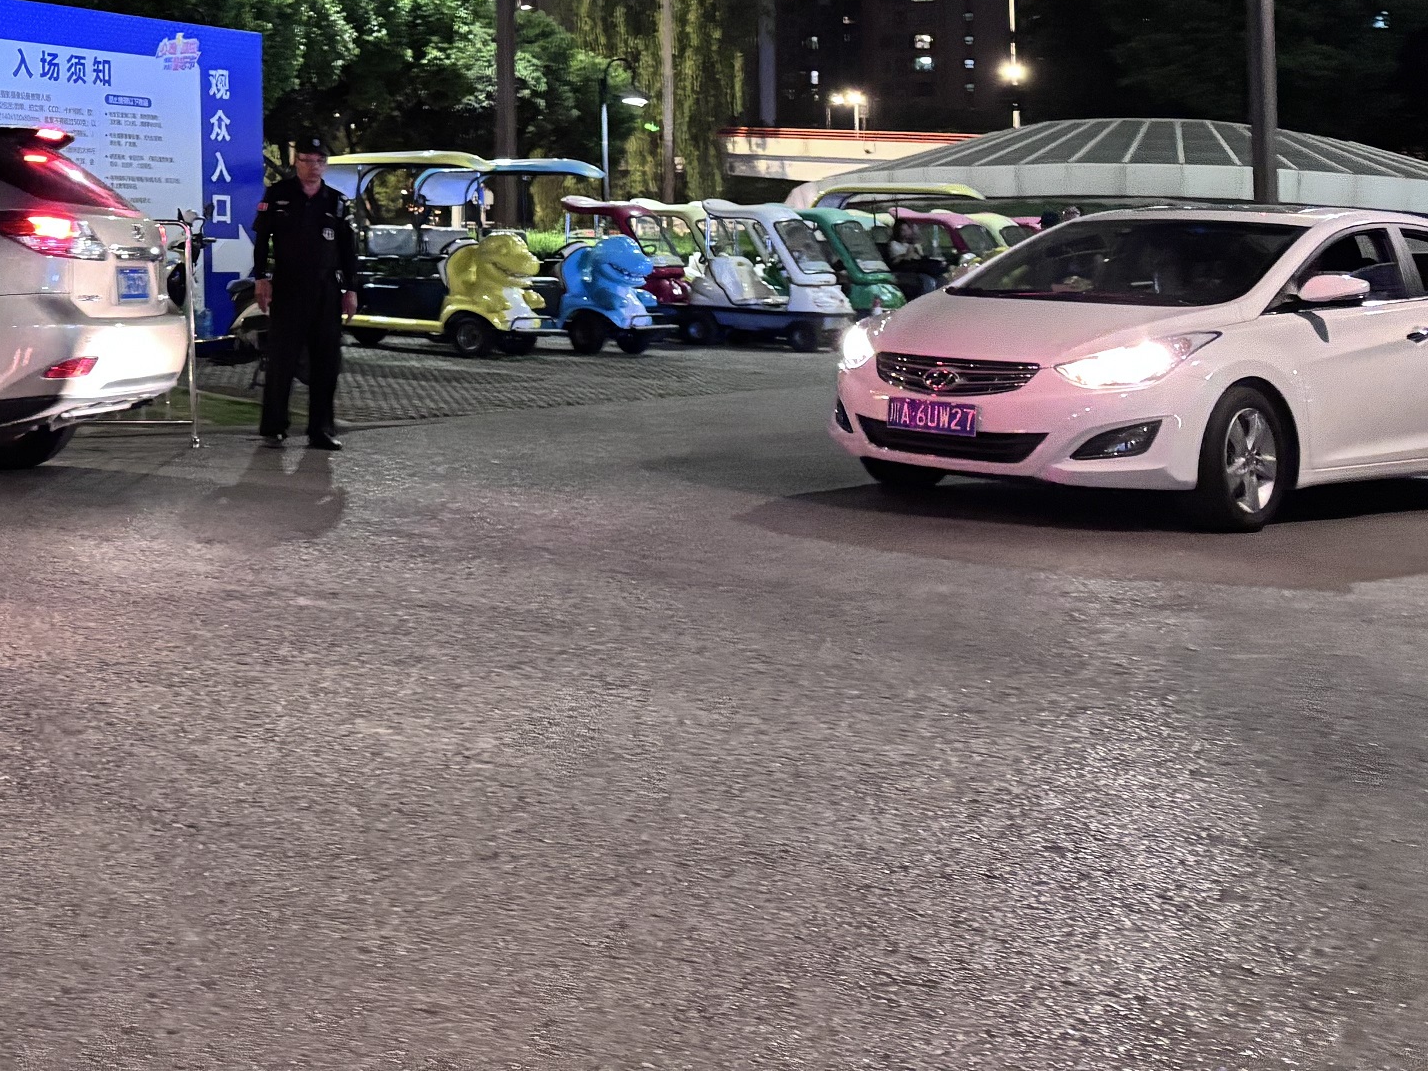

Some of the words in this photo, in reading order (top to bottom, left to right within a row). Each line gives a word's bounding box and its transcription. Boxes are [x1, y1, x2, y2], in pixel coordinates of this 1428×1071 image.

[11, 48, 113, 88] 入场须知
[208, 69, 232, 224] 观众入口
